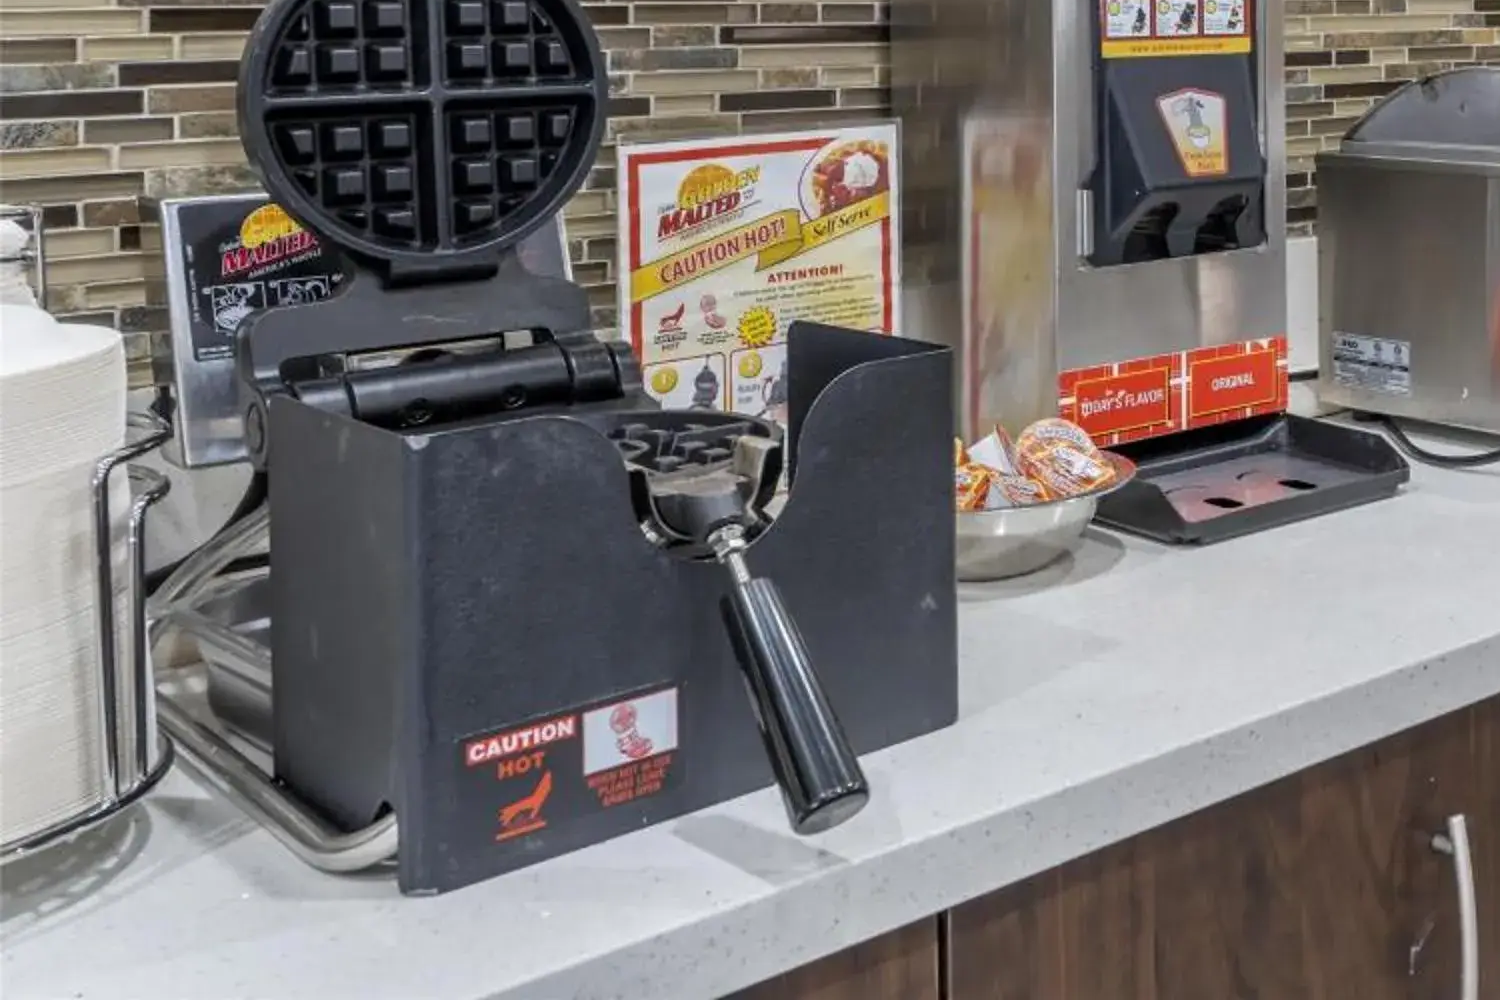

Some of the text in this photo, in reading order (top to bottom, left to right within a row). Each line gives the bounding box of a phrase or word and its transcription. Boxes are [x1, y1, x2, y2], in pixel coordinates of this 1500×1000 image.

[657, 191, 740, 238] MALTED
[812, 206, 873, 239] Self Serve
[222, 231, 311, 277] MALTED
[660, 239, 741, 284] CAUTION
[744, 217, 786, 250] HOT!
[767, 263, 844, 284] ATTENTION!
[1124, 388, 1164, 408] FLAVOR
[1211, 372, 1256, 391] ORIGINAL
[468, 719, 575, 762] CAUTION
[498, 751, 545, 779] HOT
